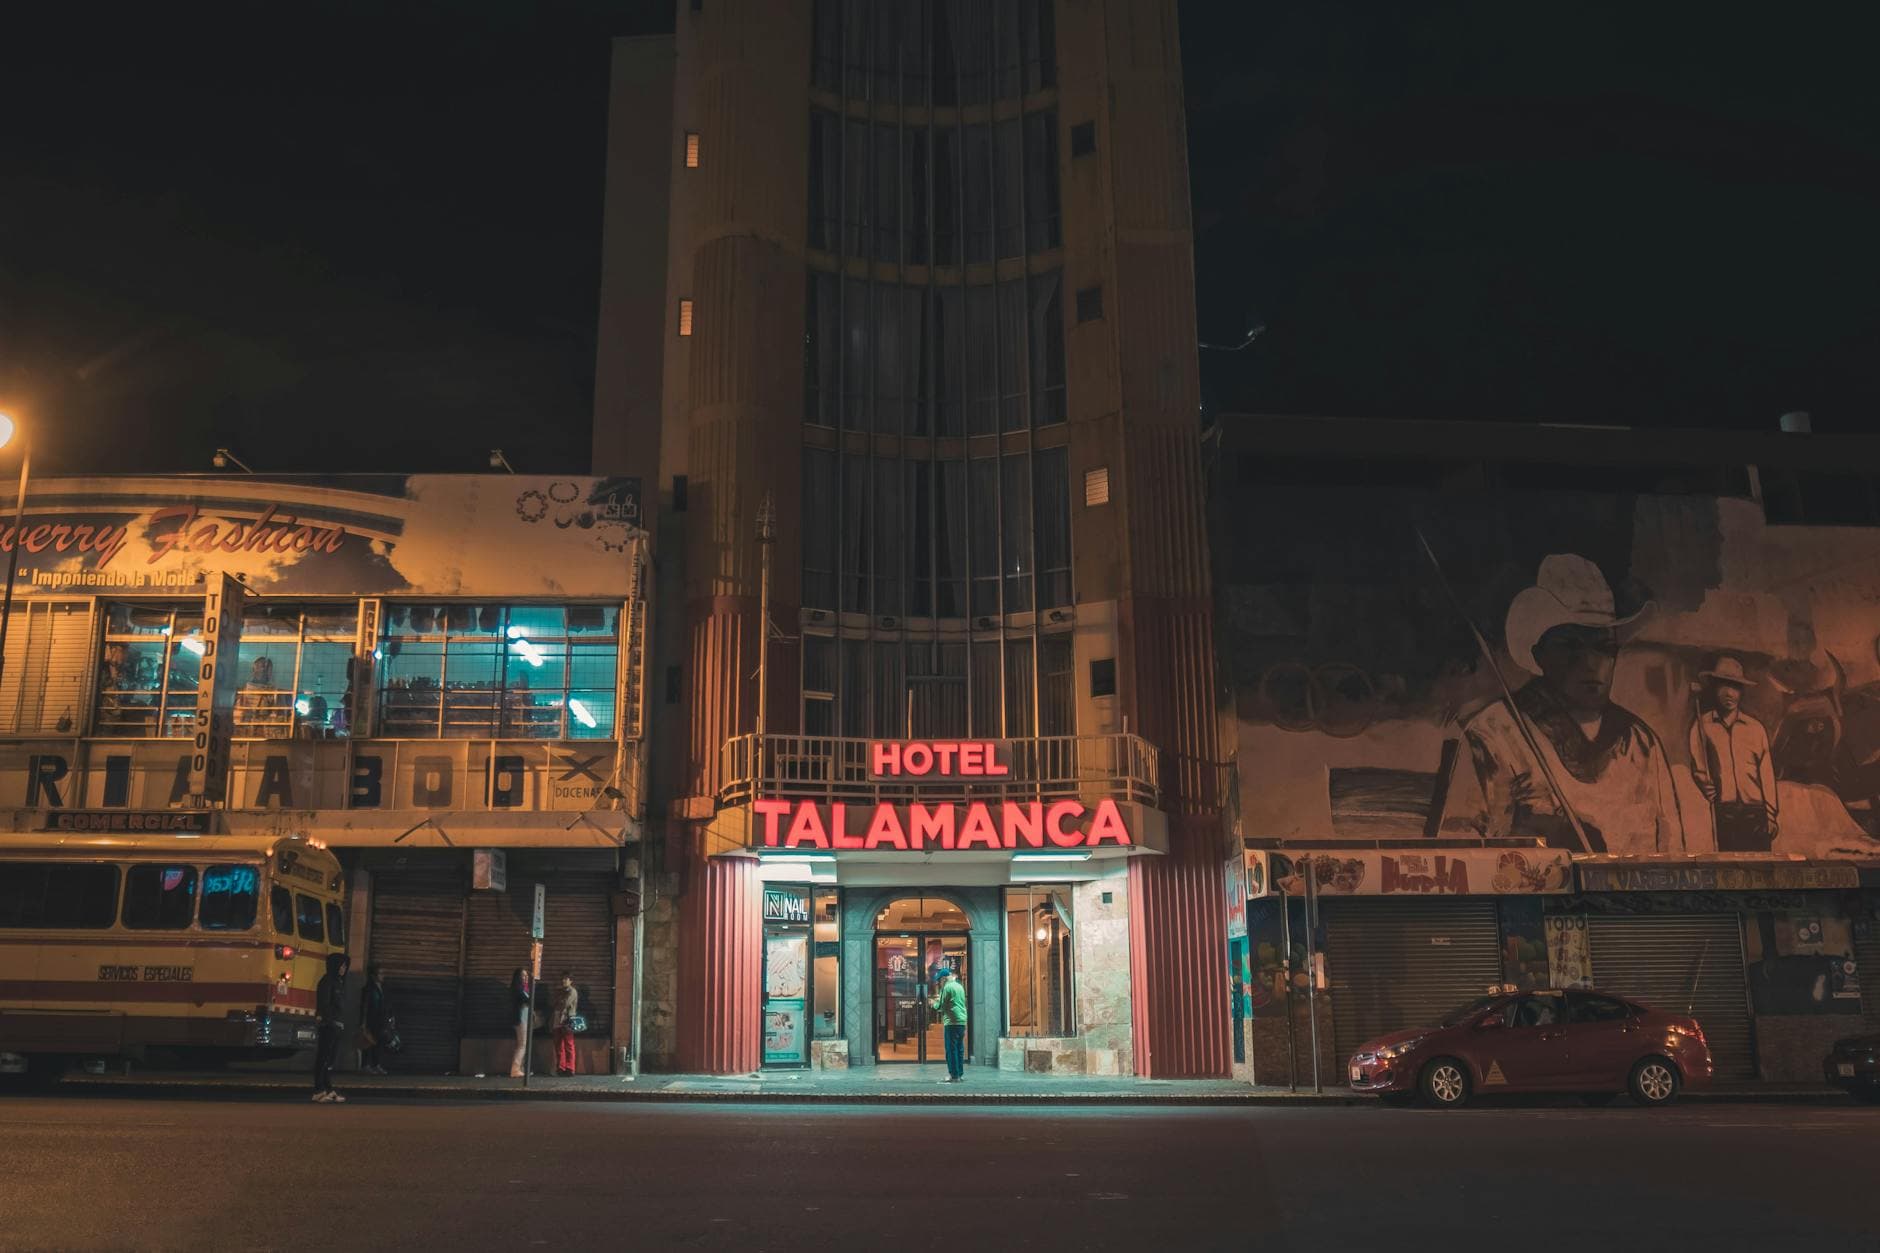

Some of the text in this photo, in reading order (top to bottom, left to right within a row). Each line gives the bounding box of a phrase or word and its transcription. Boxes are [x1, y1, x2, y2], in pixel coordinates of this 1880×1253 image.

[148, 504, 345, 564] Fashion
[32, 568, 127, 589] Imponiendo
[201, 593, 219, 681] TODO
[193, 709, 209, 772] 500
[872, 742, 1009, 776] HOTEL
[58, 814, 201, 831] COMERCIAL
[753, 800, 1132, 849] TALAMANCA
[784, 896, 807, 914] NAIL
[1545, 916, 1586, 931] TODO
[98, 966, 193, 981] SERVICIOS ESPECIALES
